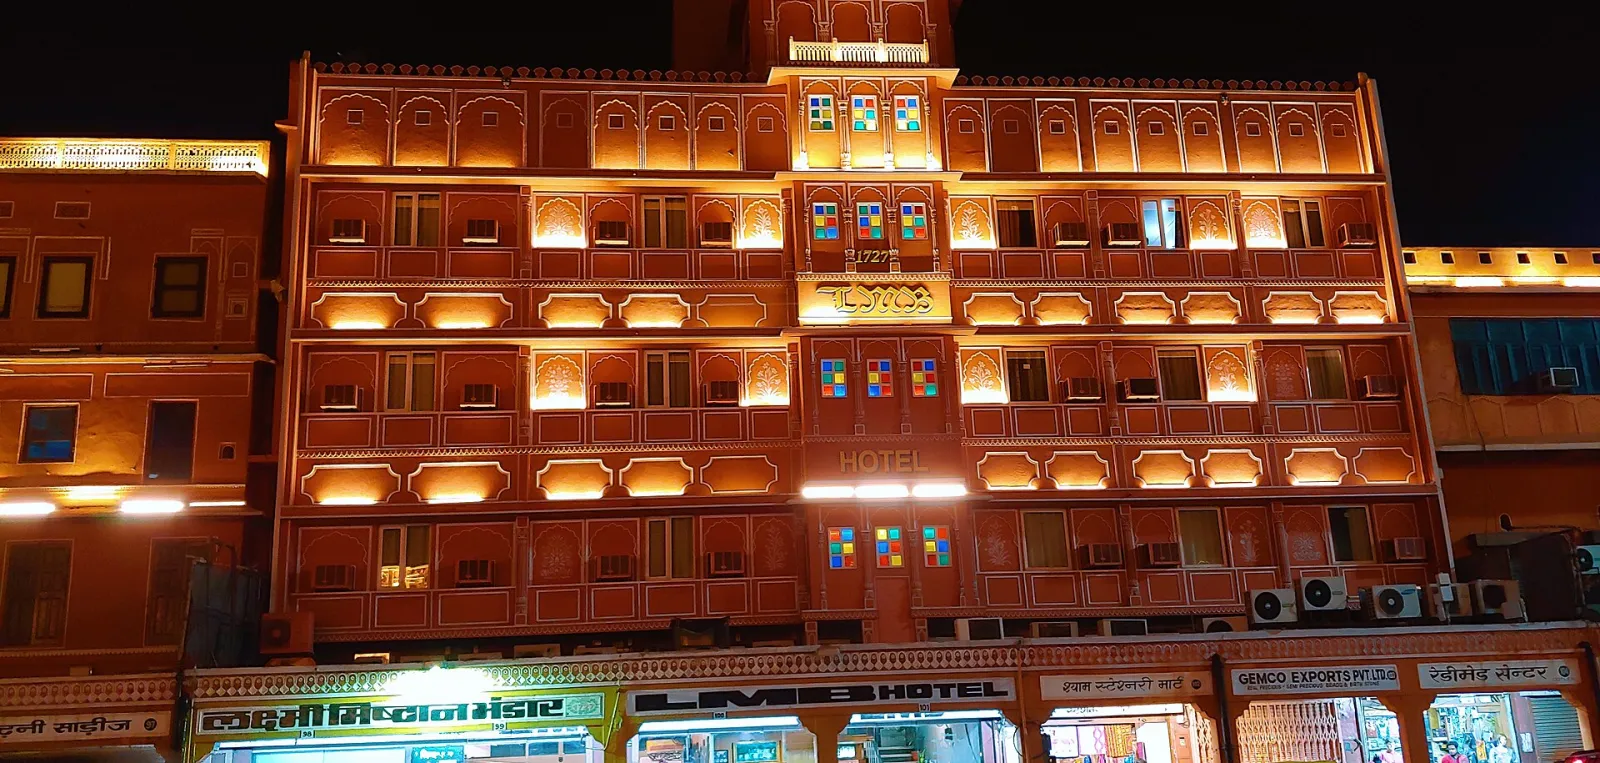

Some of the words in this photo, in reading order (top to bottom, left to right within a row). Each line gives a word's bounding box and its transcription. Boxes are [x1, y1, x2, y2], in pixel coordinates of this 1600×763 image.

[855, 250, 890, 263] 1727
[816, 285, 934, 314] LMB
[839, 450, 929, 473] HOTEL
[1238, 672, 1287, 685] GEMCO
[1291, 670, 1351, 683] EXPORTS
[1429, 665, 1490, 682] रेडीमेड
[1495, 664, 1548, 681] सेन्टर
[1062, 681, 1092, 693] श्याम
[1158, 675, 1184, 690] मार्ट
[635, 685, 876, 712] LMB
[879, 682, 1008, 700] HOTEL
[472, 697, 563, 720] भंडार
[919, 704, 930, 712] 101
[53, 716, 132, 736] साड़ीज
[302, 730, 312, 738] 98
[494, 722, 505, 730] 99
